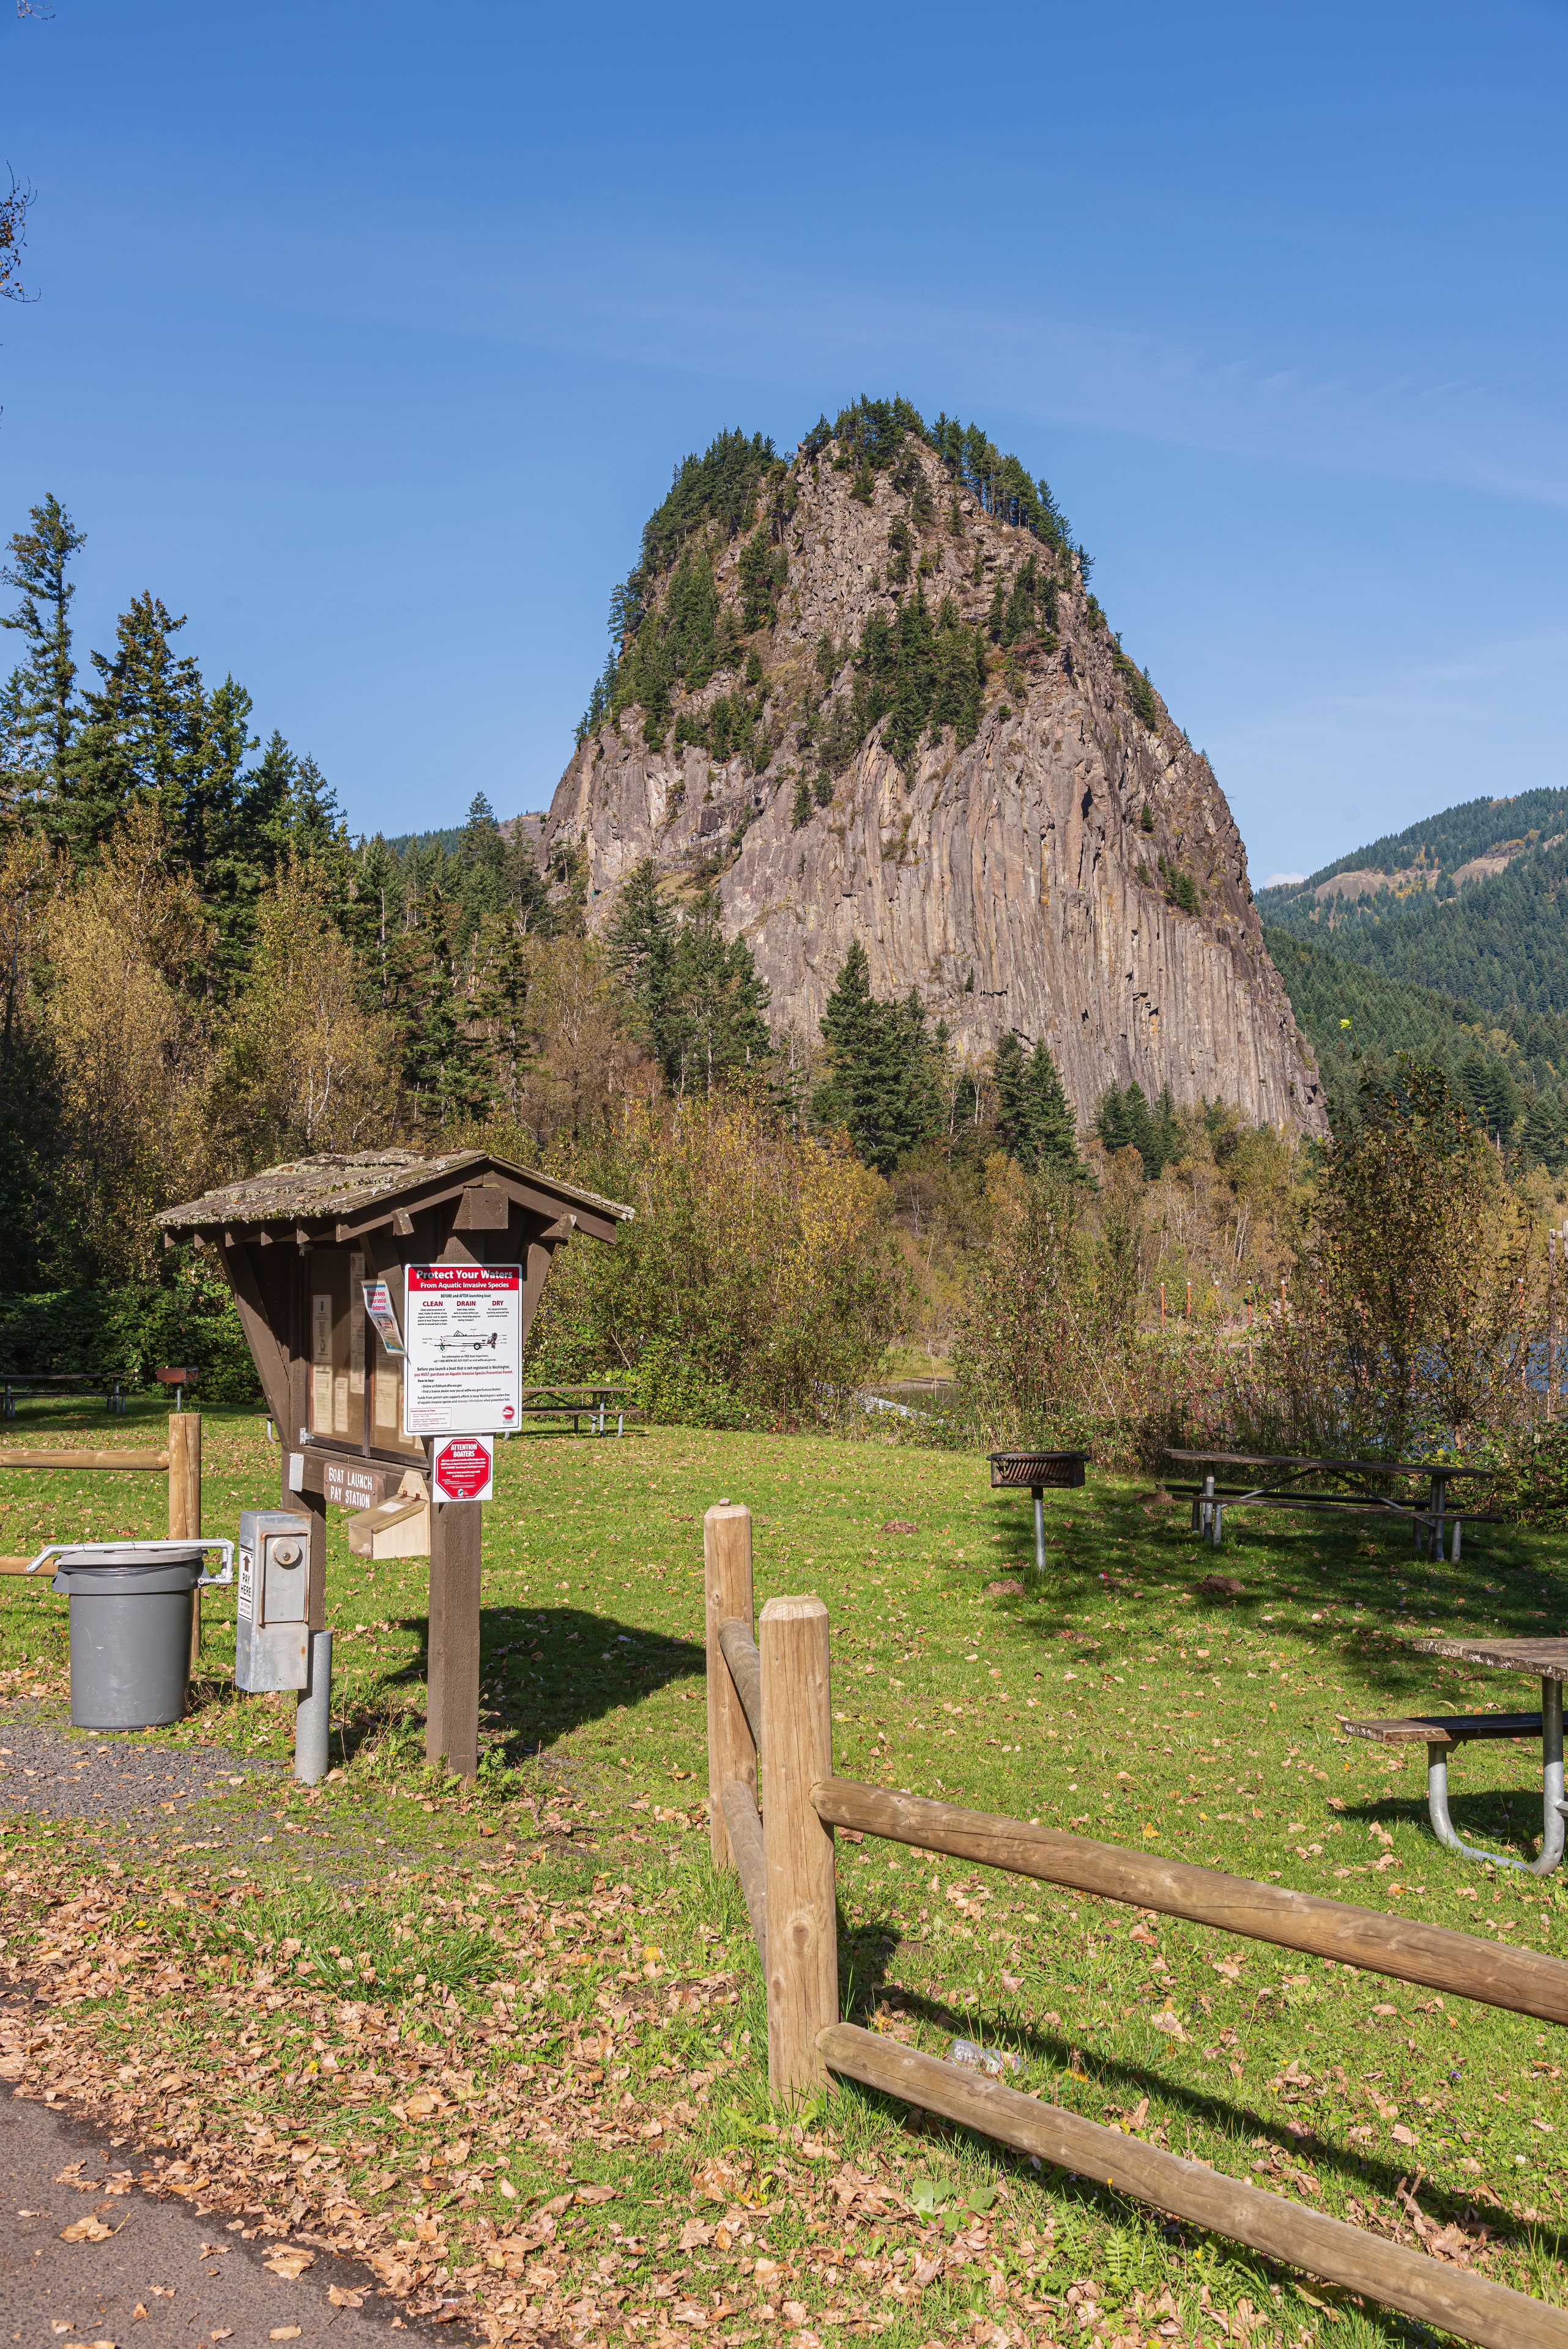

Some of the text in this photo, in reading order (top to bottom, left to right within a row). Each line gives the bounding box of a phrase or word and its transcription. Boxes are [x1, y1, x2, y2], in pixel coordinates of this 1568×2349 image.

[417, 1269, 512, 1279] Protect Your Waters
[329, 1467, 372, 1491] BOAT LAUNCH
[331, 1485, 342, 1502] PAY
[346, 1490, 370, 1508] STATION
[241, 1584, 251, 1597] HERE
